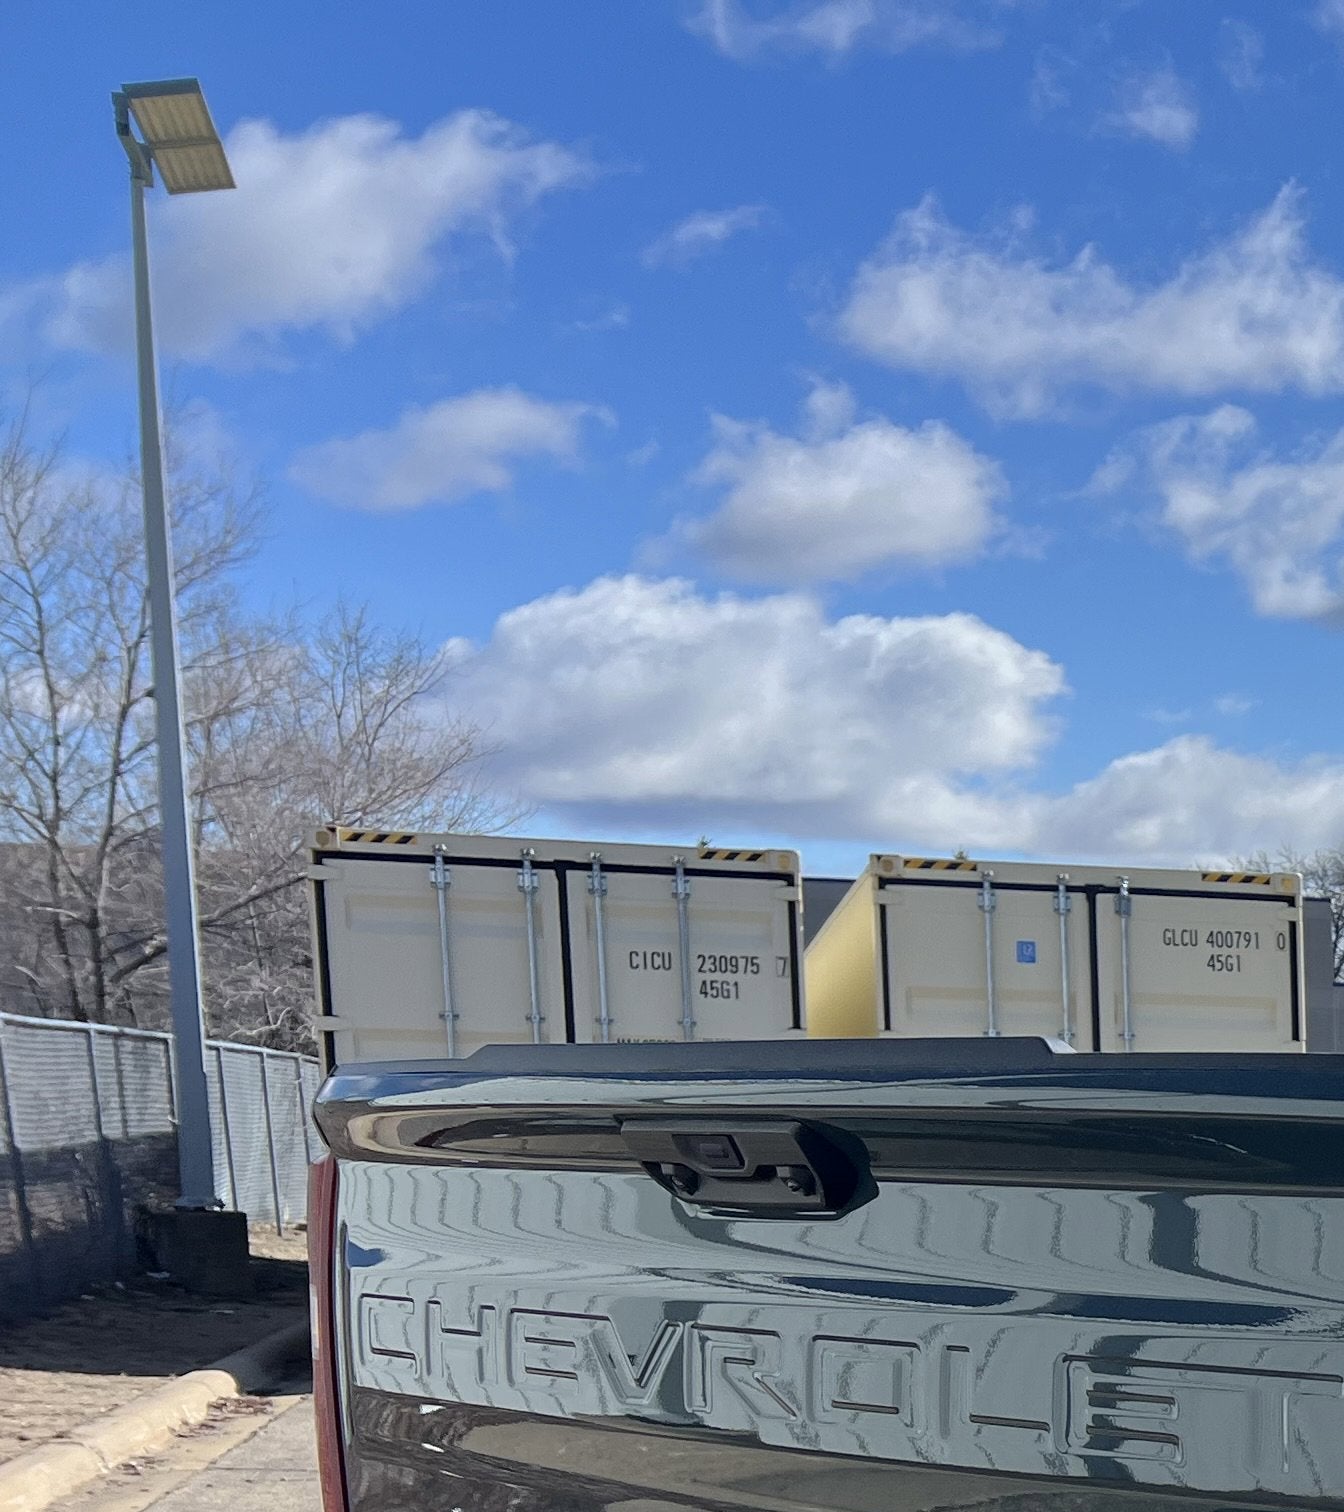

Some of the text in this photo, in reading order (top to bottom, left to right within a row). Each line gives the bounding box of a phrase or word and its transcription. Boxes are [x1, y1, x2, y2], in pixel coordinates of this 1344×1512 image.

[1162, 928, 1199, 947] GLCU
[1206, 930, 1260, 949] 400791
[629, 950, 673, 971] CICU
[697, 954, 760, 975] 230975
[1206, 954, 1242, 972] 45G1
[699, 980, 740, 999] 45G1
